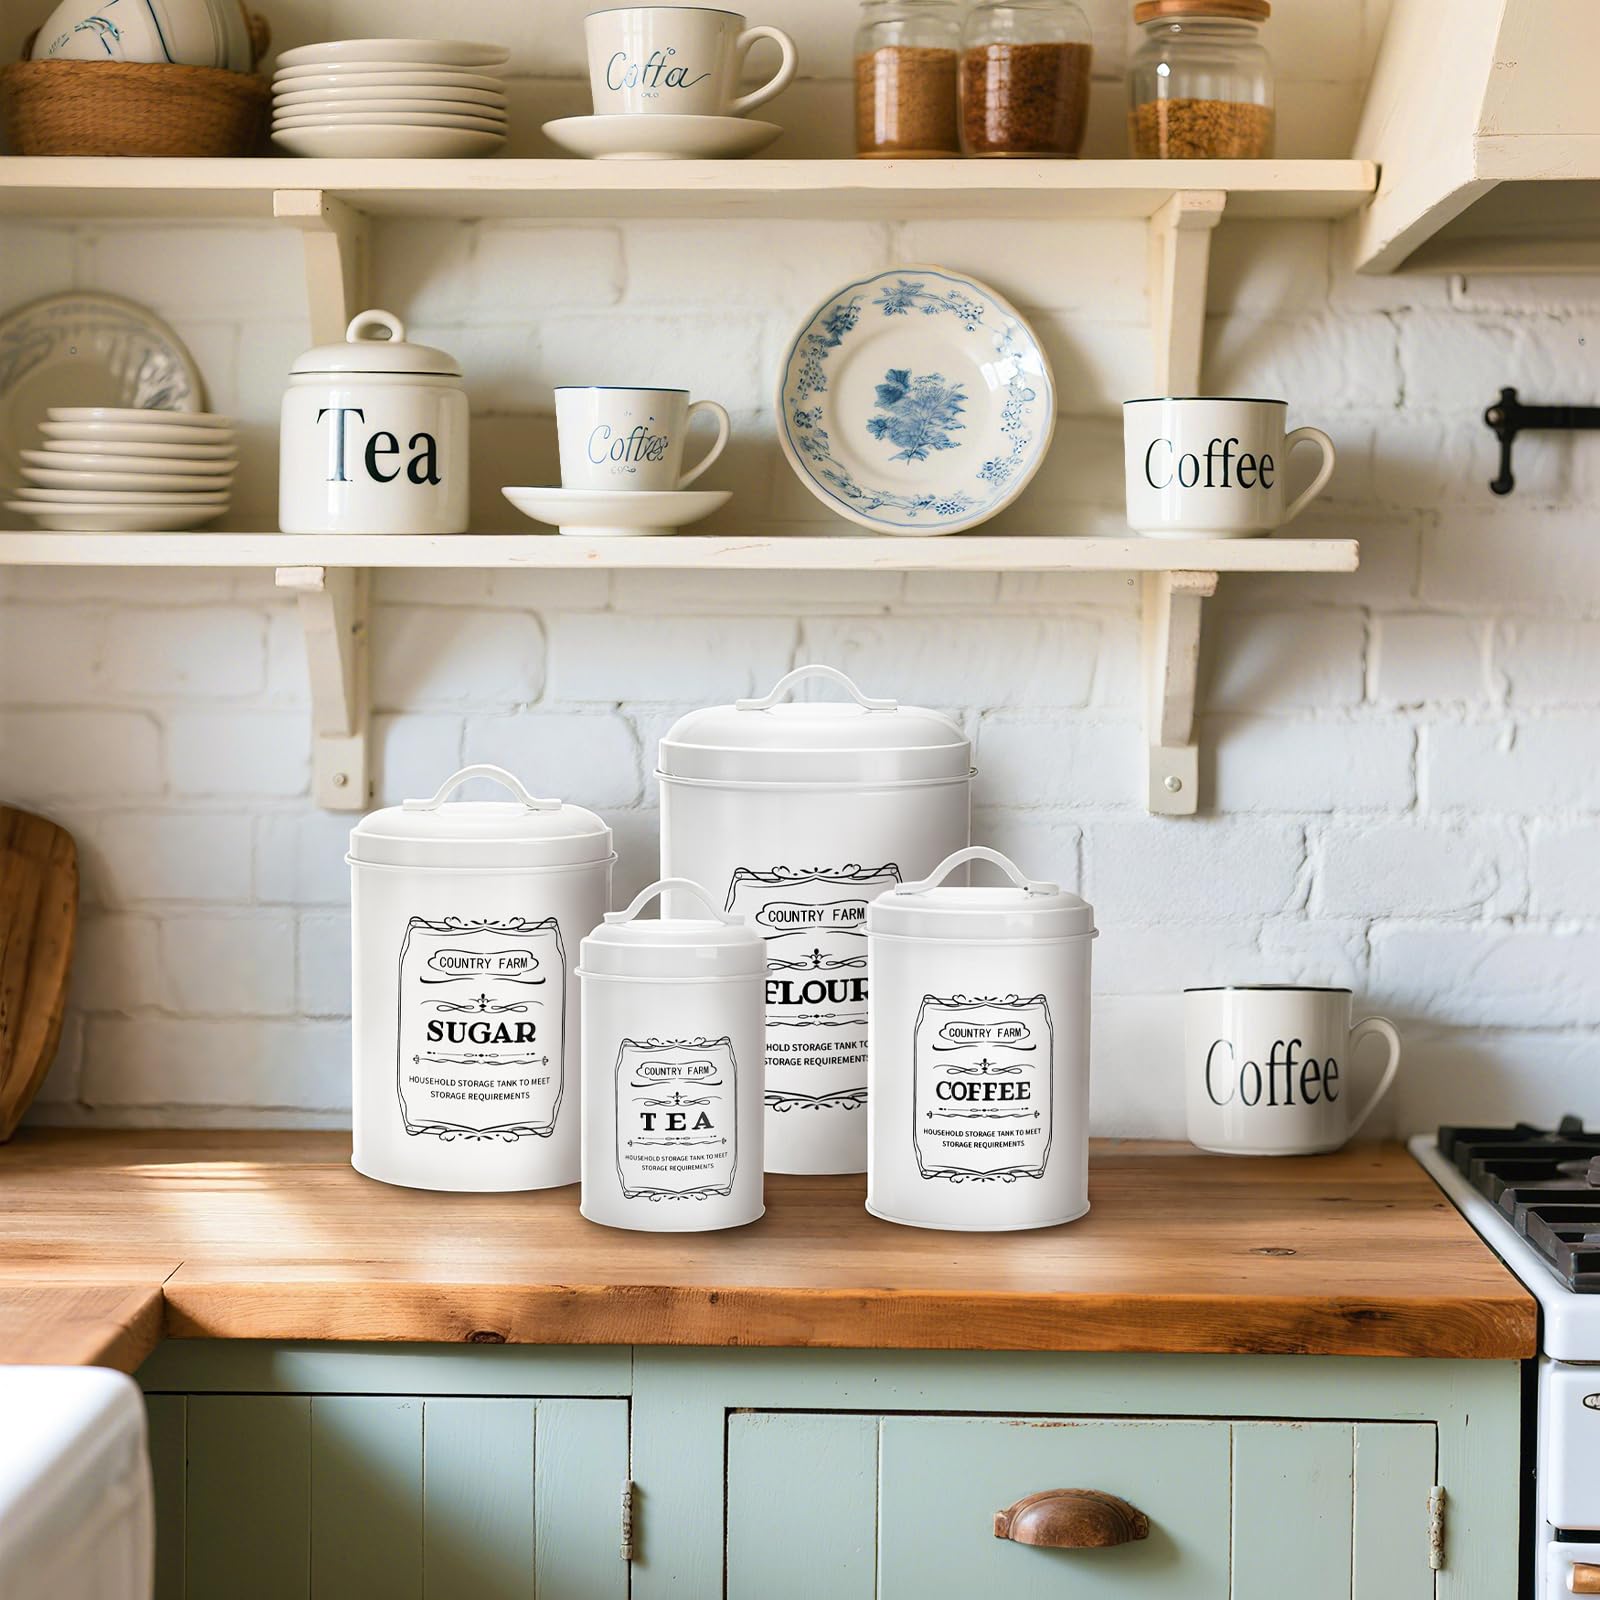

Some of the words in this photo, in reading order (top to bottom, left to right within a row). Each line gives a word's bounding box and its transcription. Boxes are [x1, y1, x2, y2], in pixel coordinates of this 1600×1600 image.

[316, 408, 442, 486] Tea
[1145, 437, 1275, 490] Coffee
[768, 909, 825, 923] COUNTRY
[832, 907, 866, 922] FARM
[439, 956, 492, 970] COUNTRY
[498, 957, 528, 969] FARM
[426, 1019, 537, 1044] SUGAR
[948, 1027, 992, 1039] COUNTRY
[997, 1028, 1022, 1038] FARM
[792, 1042, 833, 1052] STORAGE
[833, 1041, 858, 1051] TANK
[644, 1067, 682, 1076] COUNTRY
[687, 1066, 710, 1075] FARM
[1205, 1038, 1340, 1107] Coffee
[408, 1075, 457, 1087] HOUSEHOLD
[457, 1079, 495, 1089] STORAGE
[496, 1079, 518, 1088] TANK
[519, 1078, 530, 1087] TO
[531, 1076, 551, 1086] MEET
[430, 1090, 467, 1101] STORAGE
[467, 1091, 531, 1102] REQUIREMENTS
[935, 1080, 1032, 1102] COFFEE
[639, 1111, 715, 1132] TEA
[923, 1127, 964, 1138] HOUSEHOLD
[965, 1130, 996, 1138] STORAGE
[996, 1130, 1015, 1138] TANK
[1015, 1128, 1025, 1137] TO
[1025, 1127, 1042, 1136] MEET
[941, 1140, 973, 1149] STORAGE
[973, 1140, 1026, 1150] REQUIREMENTS
[661, 1155, 689, 1163] STORAGE
[641, 1164, 668, 1172] STORAGE
[669, 1163, 714, 1172] REQUIREMENTS
